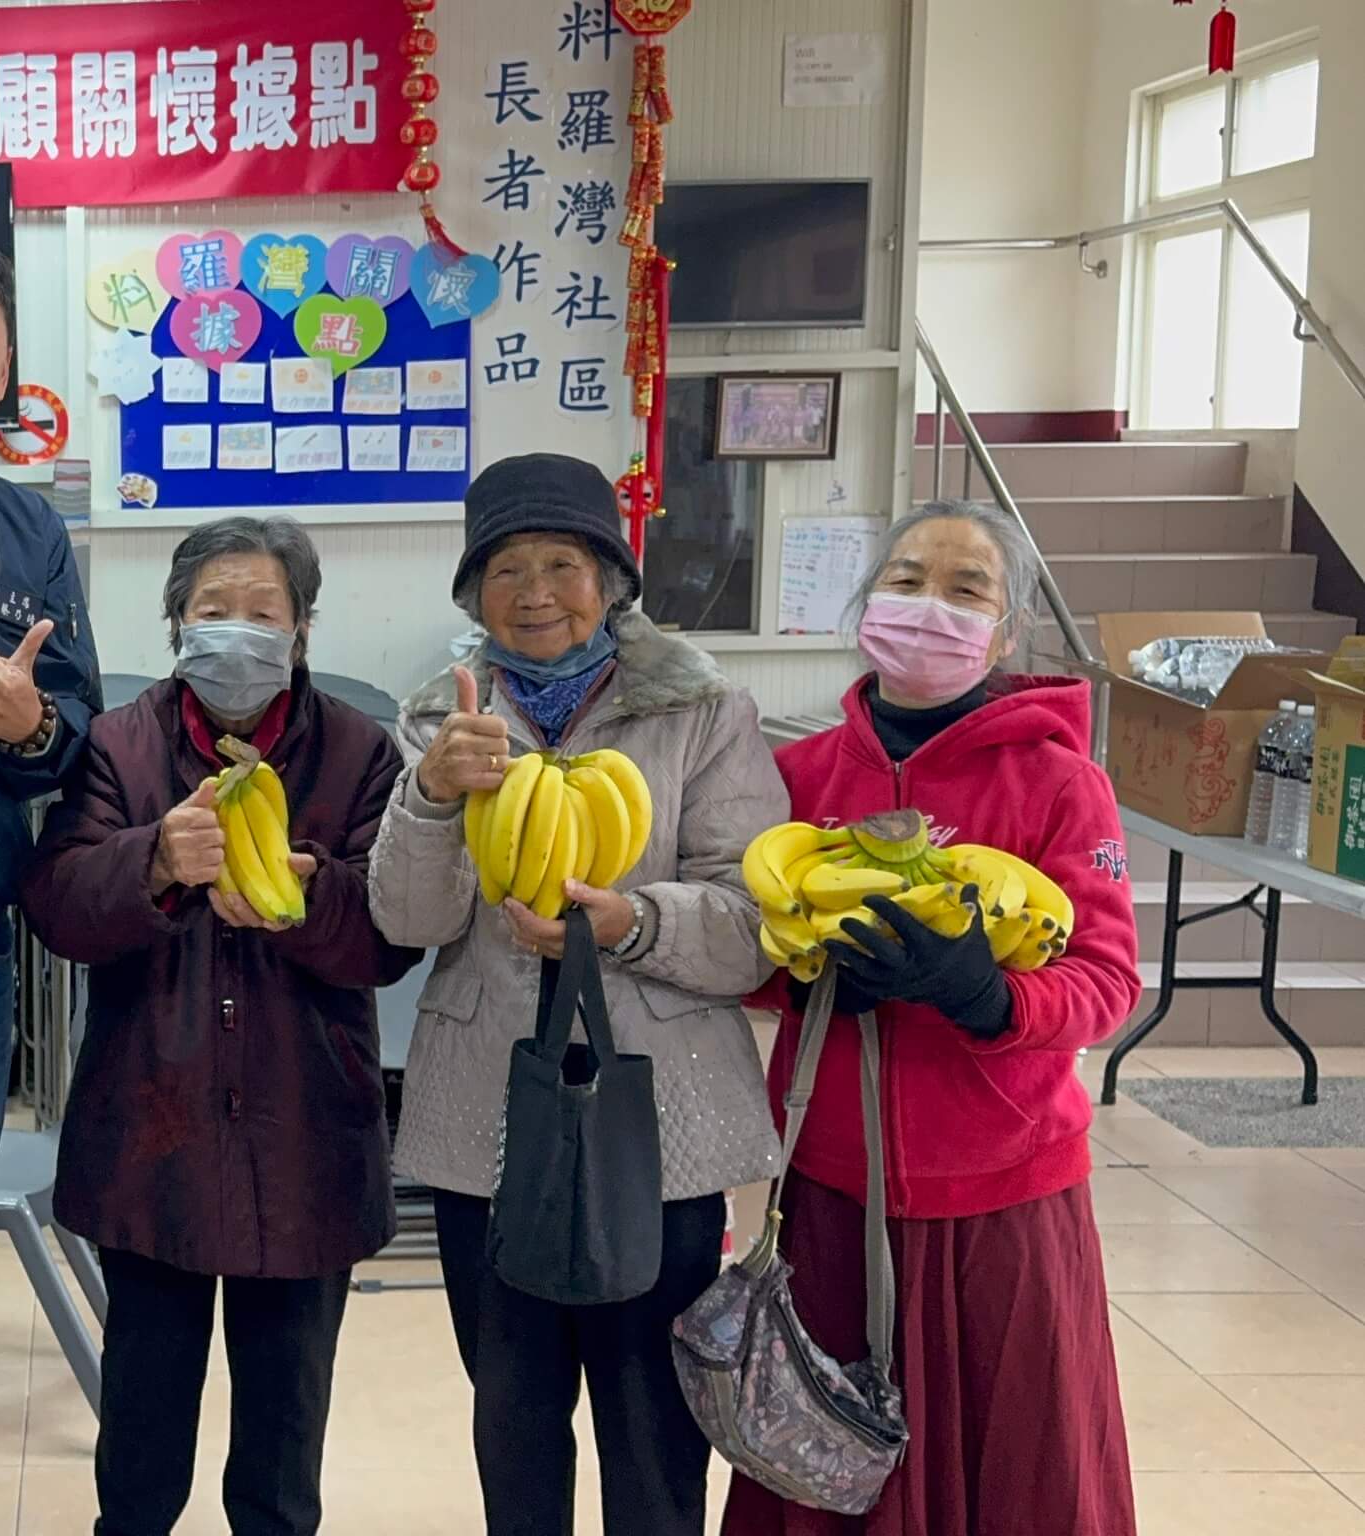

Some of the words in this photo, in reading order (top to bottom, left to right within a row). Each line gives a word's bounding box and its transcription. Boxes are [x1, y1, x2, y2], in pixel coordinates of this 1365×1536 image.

[482, 61, 546, 385] 長者作品
[551, 1, 622, 412] 料羅灣社區
